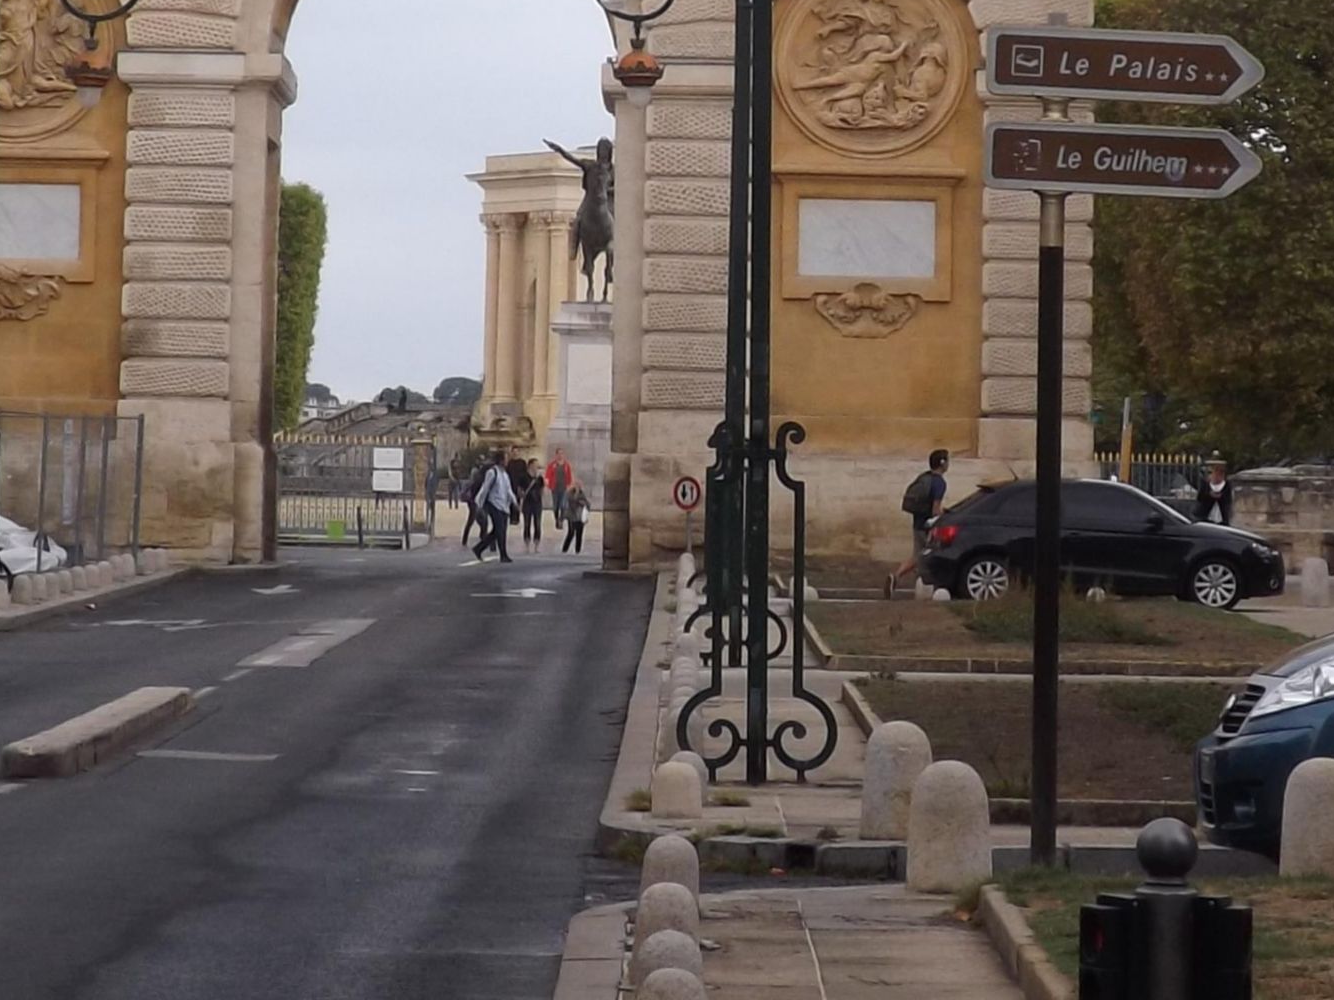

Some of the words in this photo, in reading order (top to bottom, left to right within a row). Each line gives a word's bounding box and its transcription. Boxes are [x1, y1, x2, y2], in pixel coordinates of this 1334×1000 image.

[1058, 51, 1090, 75] Le
[1108, 53, 1200, 82] Palais
[1056, 145, 1083, 169] Le
[1093, 146, 1188, 174] Guilhem
